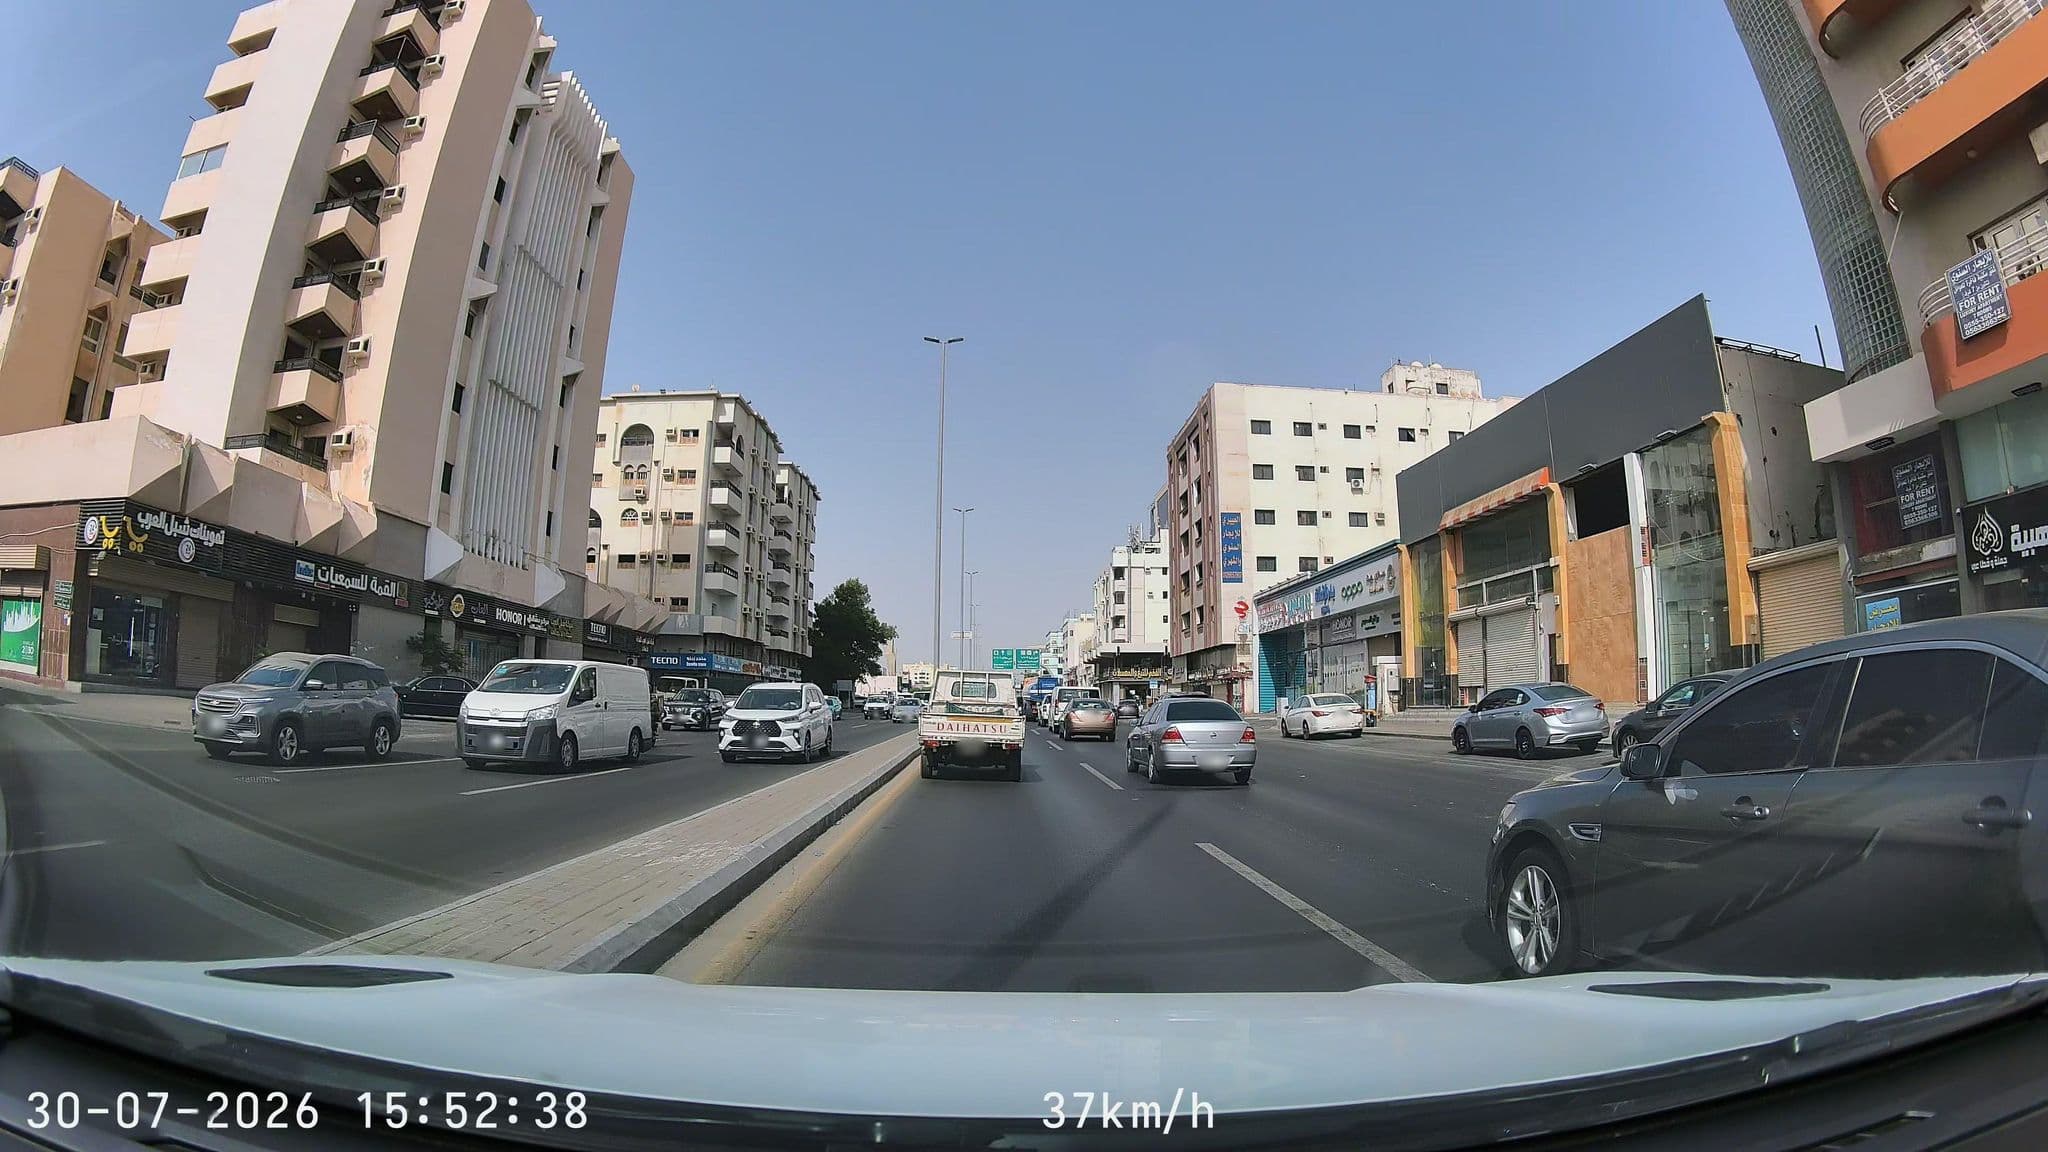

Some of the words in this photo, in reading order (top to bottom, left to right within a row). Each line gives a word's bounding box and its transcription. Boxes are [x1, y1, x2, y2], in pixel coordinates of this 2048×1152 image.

[1959, 296, 1976, 311] FOR
[1977, 284, 2000, 303] RENT
[1900, 493, 1915, 504] FOR
[1916, 485, 1935, 499] RENT
[137, 511, 167, 530] العرب
[164, 514, 190, 537] شبل
[189, 521, 226, 547] تموينات
[370, 576, 396, 598] القمة
[495, 607, 523, 626] HONOR
[651, 656, 679, 665] TECNO
[937, 722, 1007, 734] DAIHATSU
